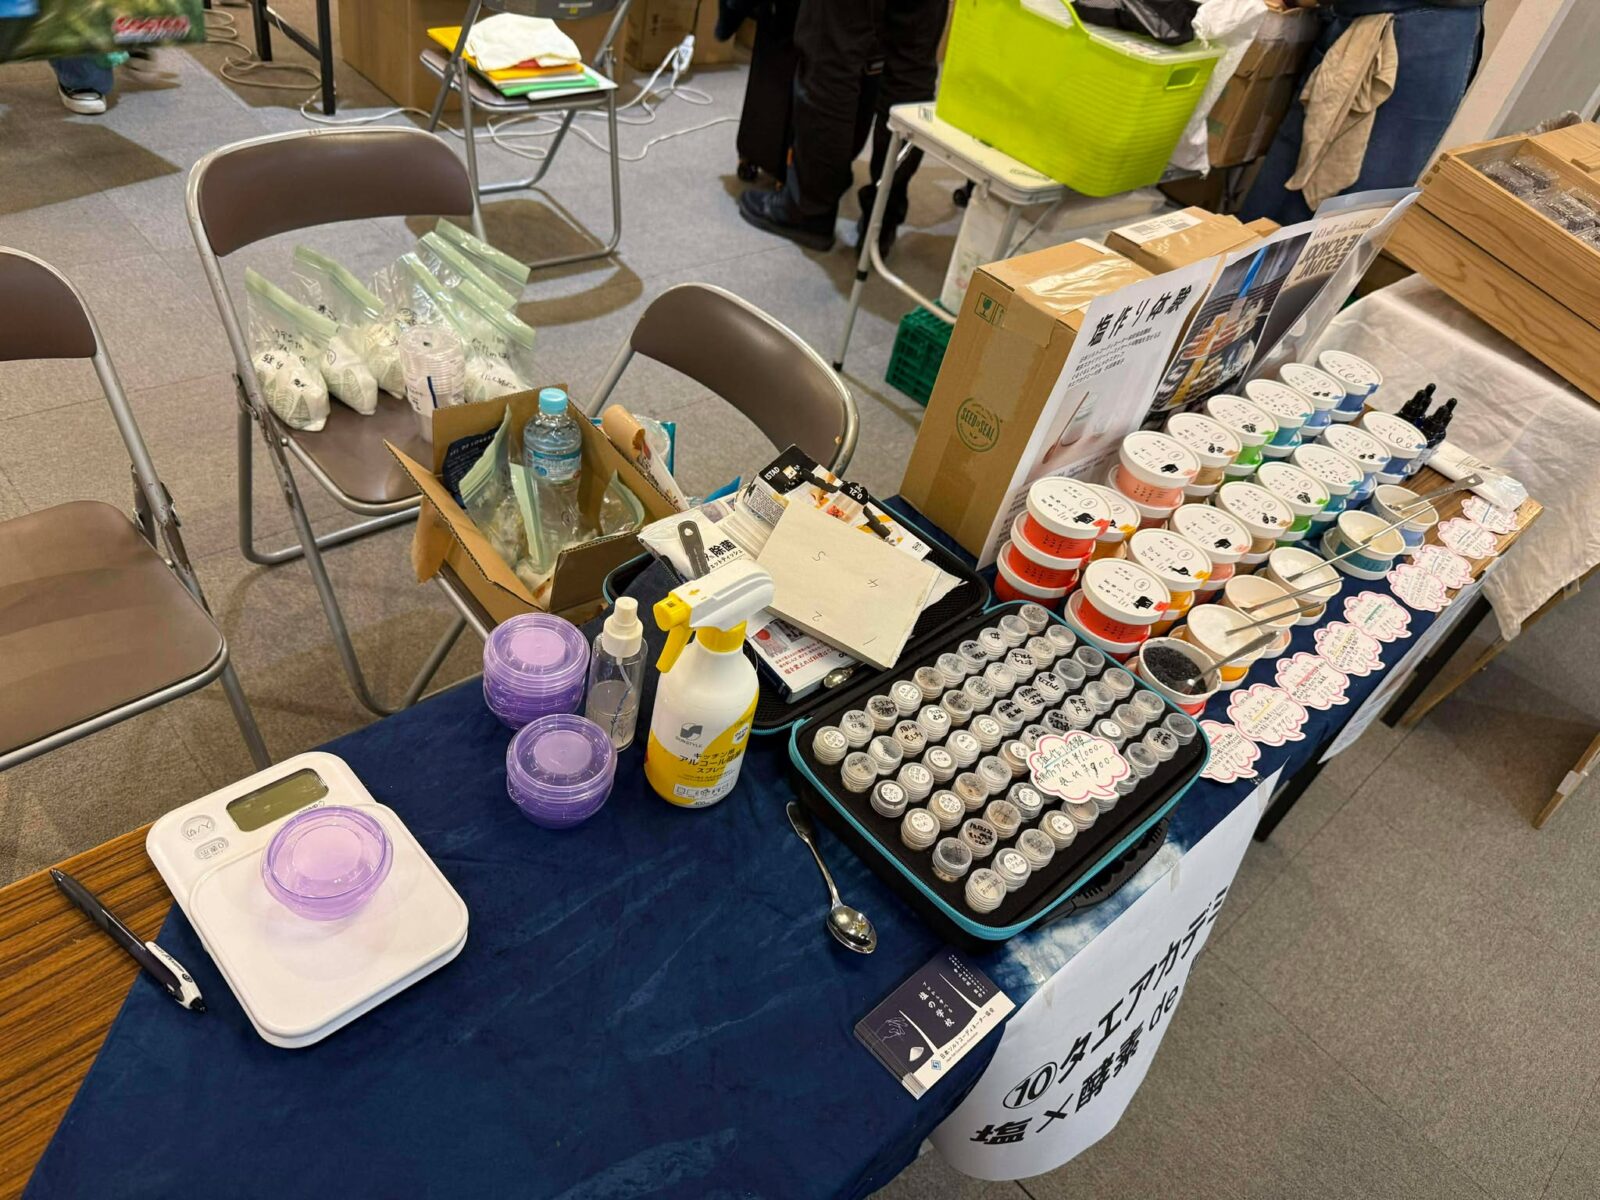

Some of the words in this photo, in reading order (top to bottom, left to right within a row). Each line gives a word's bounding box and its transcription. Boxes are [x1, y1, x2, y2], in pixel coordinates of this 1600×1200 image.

[1088, 285, 1192, 347] 塩作り体験
[764, 466, 781, 481] ISTAD
[693, 748, 735, 760] キッチン用
[696, 766, 726, 774] スプレー
[917, 991, 955, 1028] 塩の学校
[1148, 985, 1180, 1033] de
